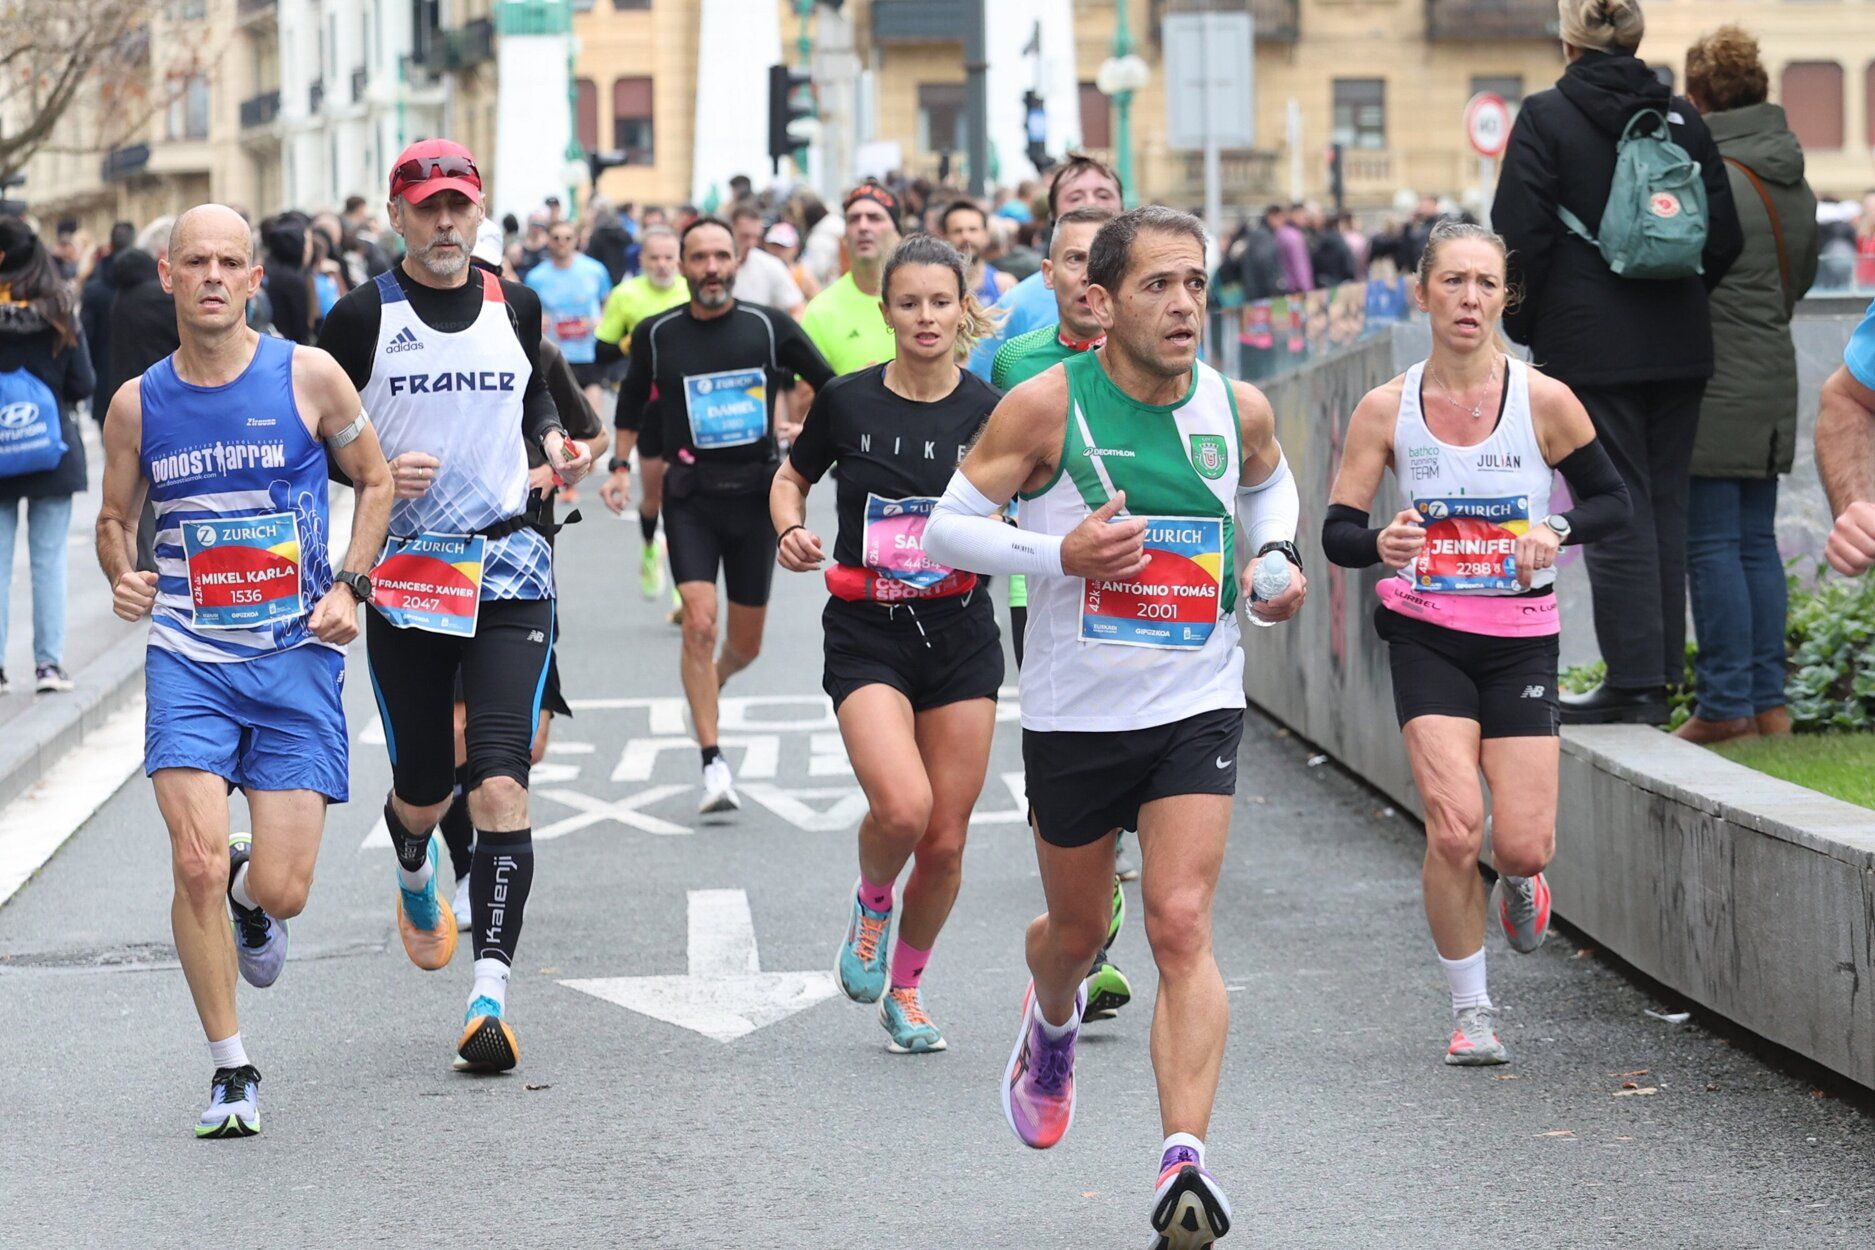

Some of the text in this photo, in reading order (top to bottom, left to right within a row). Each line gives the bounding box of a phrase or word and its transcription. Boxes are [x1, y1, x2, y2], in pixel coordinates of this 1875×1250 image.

[386, 341, 424, 354] adidas
[389, 371, 516, 396] FRANCE
[1093, 448, 1136, 458] DECATHLON
[1476, 452, 1521, 468] JULIÁN
[1409, 465, 1440, 481] TEAM
[1453, 504, 1512, 518] ZURICH
[222, 526, 278, 542] ZURICH
[1143, 529, 1203, 544] ZURICH
[411, 540, 465, 555] ZURICH
[1430, 538, 1517, 555] JENNIFE
[201, 572, 245, 586] MIKEL
[246, 565, 295, 583] KARLA
[1456, 562, 1491, 576] 2288
[230, 589, 262, 604] 1536
[378, 579, 434, 594] FRANCESC
[435, 585, 475, 598] XAVIER
[1101, 579, 1169, 597] ANTÓNIO
[1171, 583, 1216, 598] TOMÁS
[402, 595, 440, 611] 2047
[1394, 589, 1441, 611] LURBEL
[1136, 602, 1178, 619] 2001
